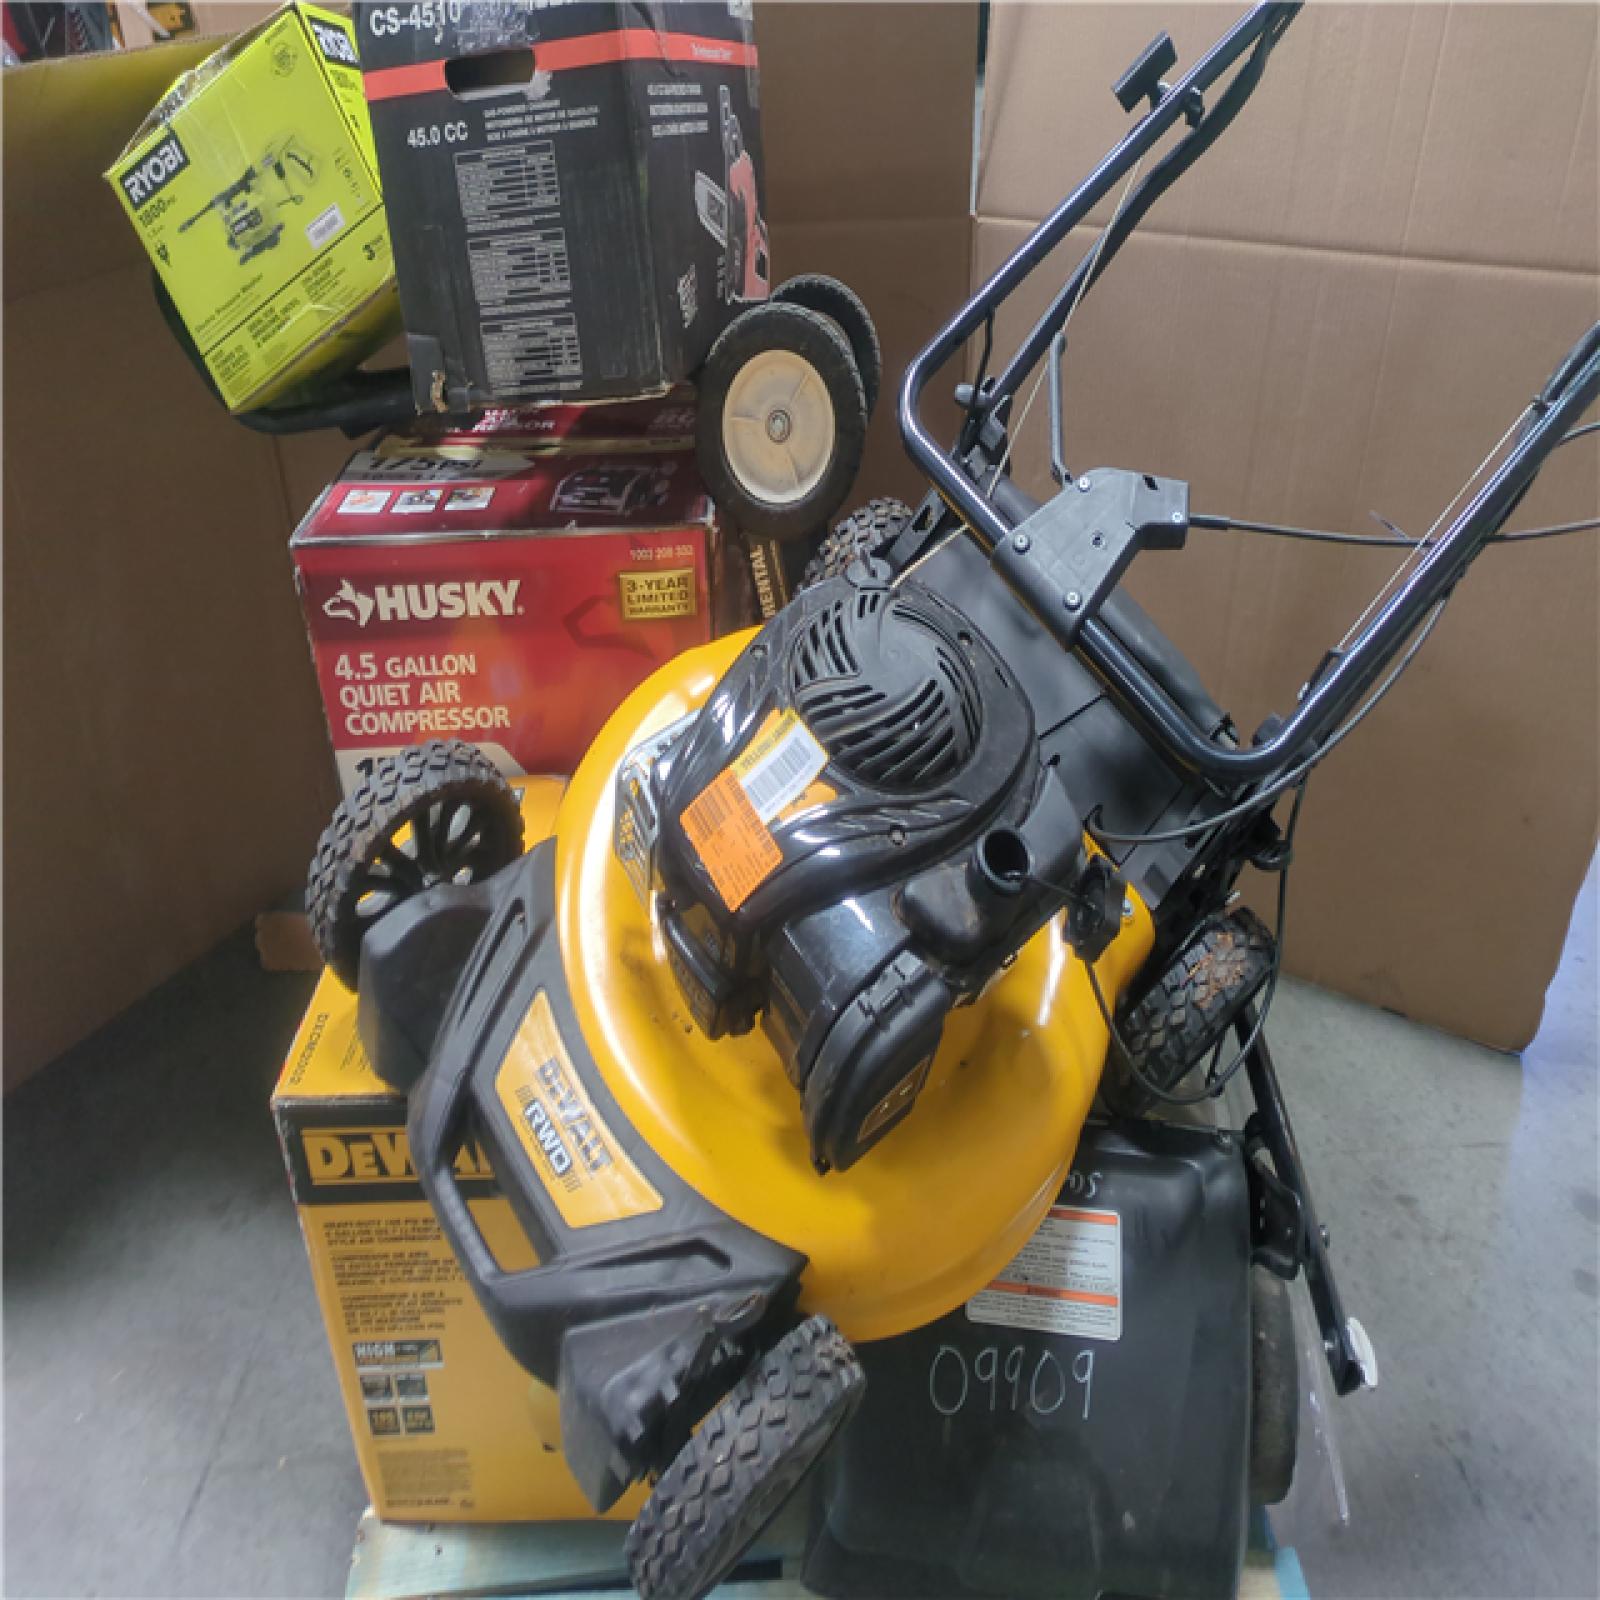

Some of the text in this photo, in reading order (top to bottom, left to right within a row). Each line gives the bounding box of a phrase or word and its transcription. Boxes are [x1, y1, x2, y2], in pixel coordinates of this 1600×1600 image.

[369, 1, 461, 37] CS-4510
[406, 120, 468, 149] 45.0 CC
[124, 139, 185, 204] RYOBI
[374, 580, 521, 620] HUSKY
[626, 576, 689, 593] 3-YEAR
[626, 591, 689, 604] LIMITED
[334, 652, 477, 680] 4.5 GALLON
[339, 679, 461, 712] QUIET AIR
[345, 705, 512, 737] COMPRESSOR
[524, 1099, 571, 1175] RWD
[929, 1344, 1096, 1420] 09909
